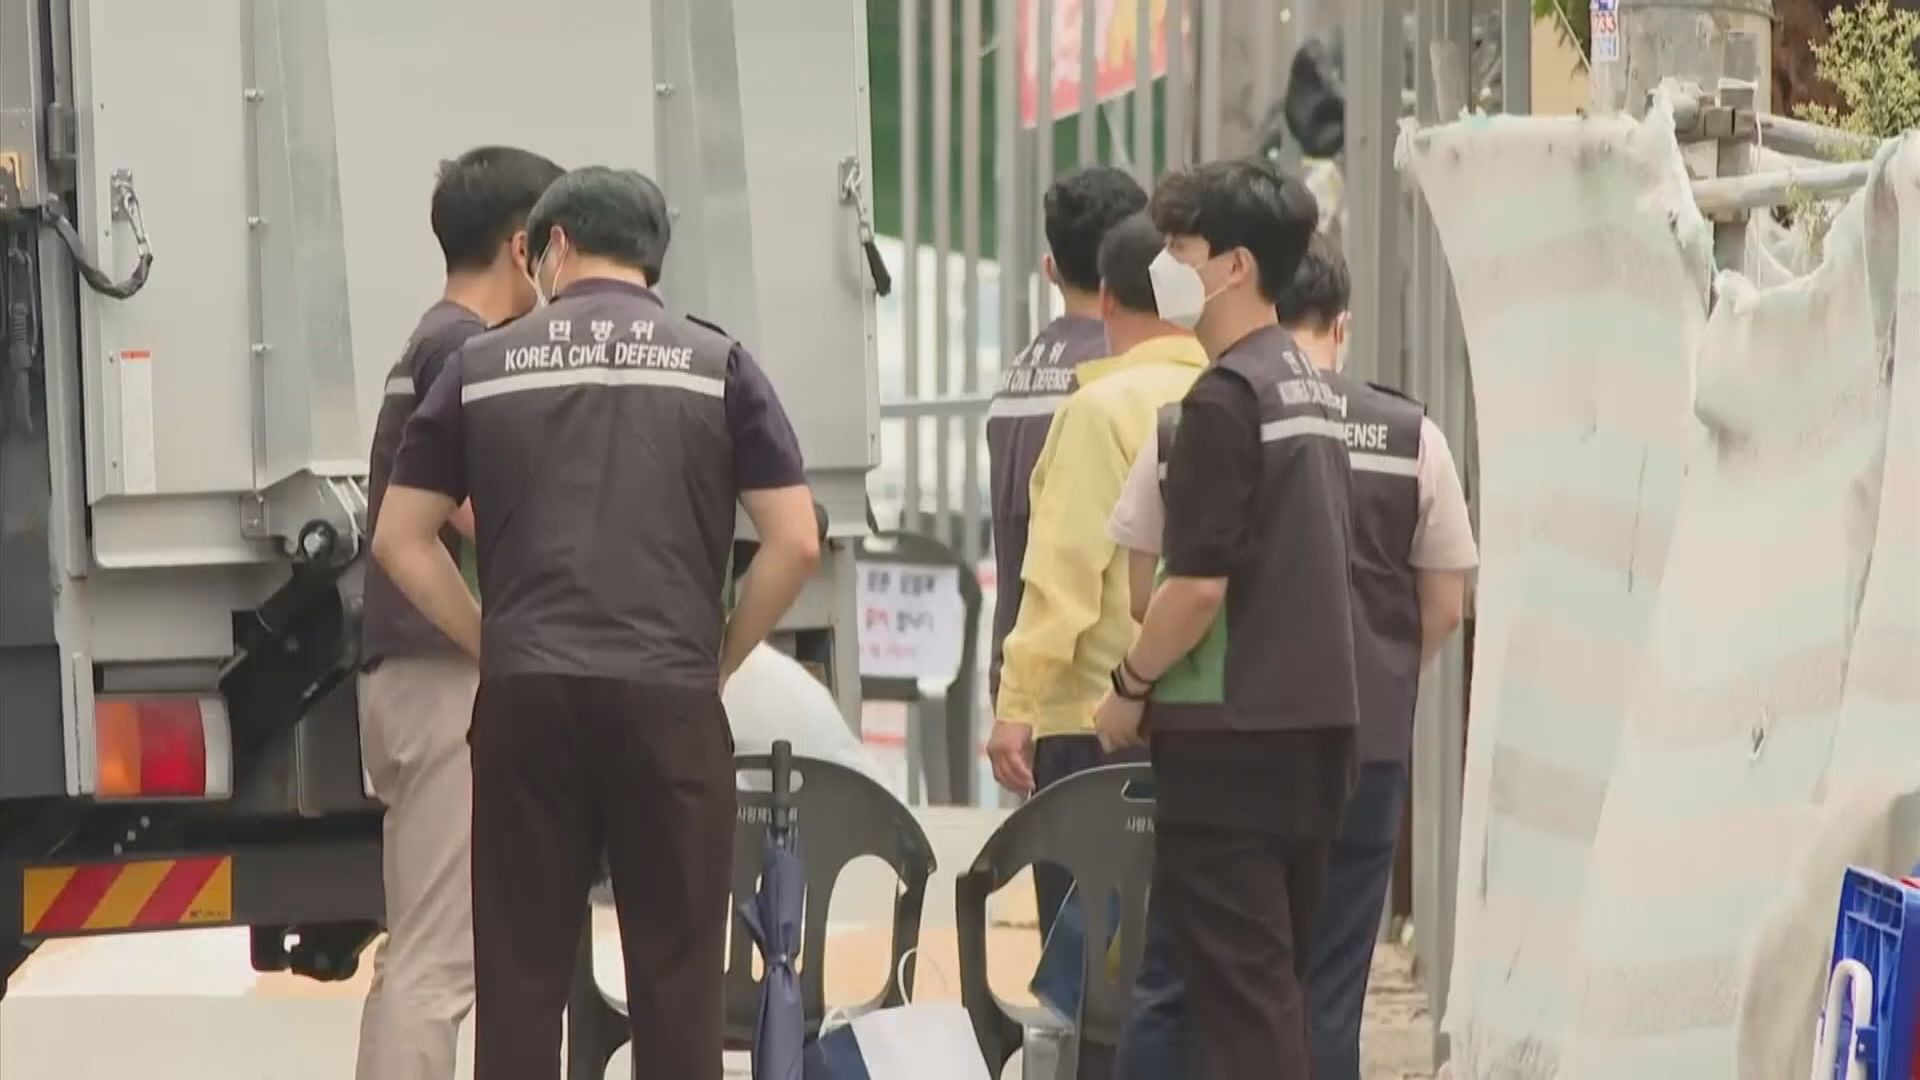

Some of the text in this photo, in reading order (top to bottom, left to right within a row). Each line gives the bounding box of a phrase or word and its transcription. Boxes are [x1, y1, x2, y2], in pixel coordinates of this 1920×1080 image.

[505, 342, 693, 372] KOREA CIVIL DEFENSE
